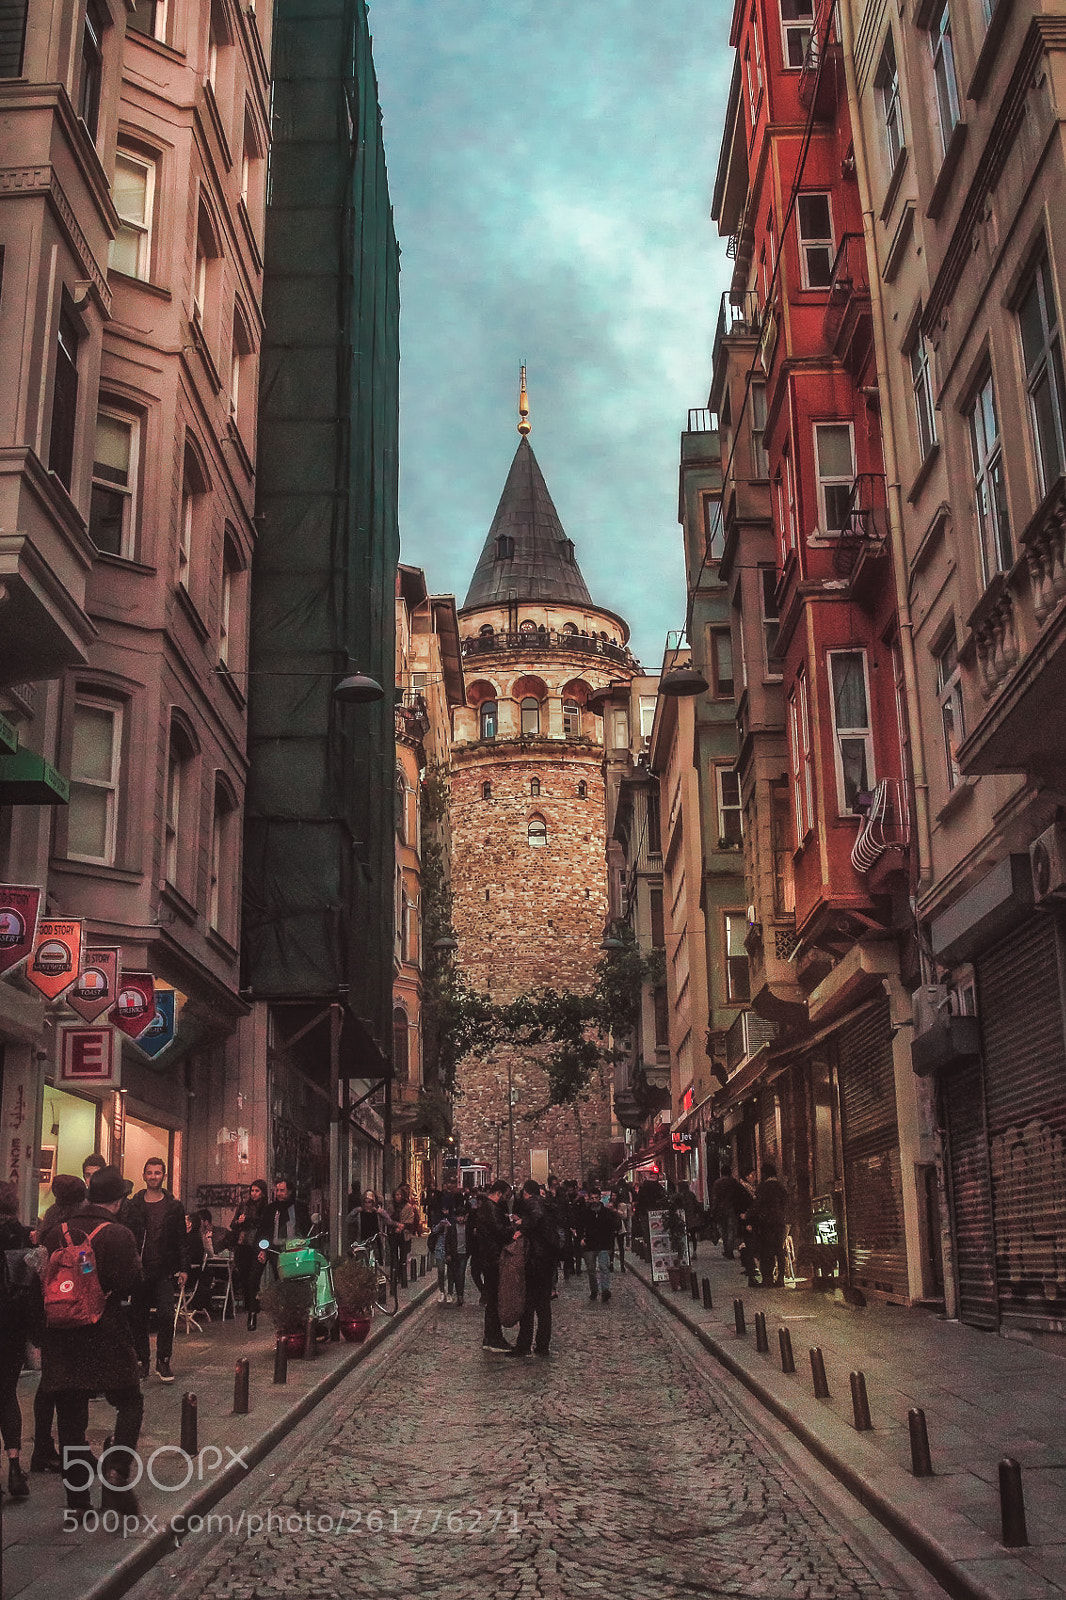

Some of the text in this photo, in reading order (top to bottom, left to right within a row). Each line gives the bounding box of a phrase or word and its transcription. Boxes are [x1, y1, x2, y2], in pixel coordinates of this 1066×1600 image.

[39, 925, 75, 936] OOD STORY
[91, 953, 110, 963] STORY
[72, 1034, 103, 1072] E
